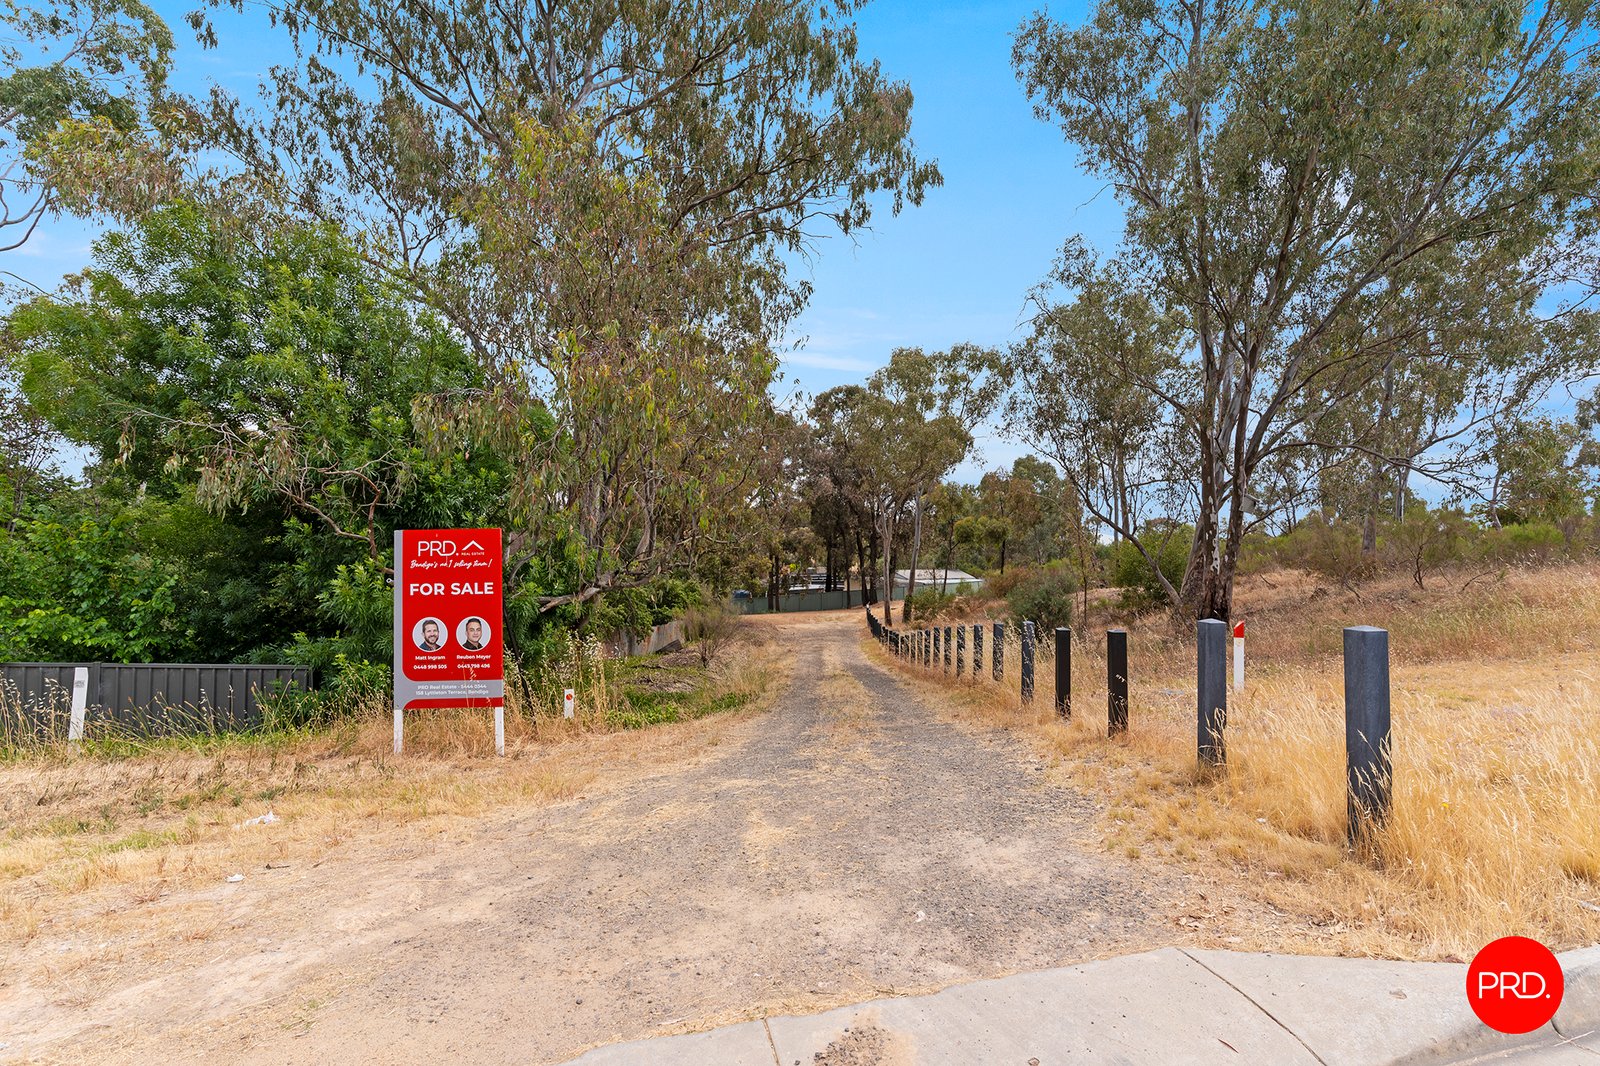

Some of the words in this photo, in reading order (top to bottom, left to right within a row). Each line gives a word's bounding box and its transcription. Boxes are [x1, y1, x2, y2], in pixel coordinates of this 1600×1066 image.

[410, 559, 438, 570] Bendigo's
[453, 560, 473, 570] selling
[410, 582, 445, 596] FOR
[450, 582, 494, 595] SALE
